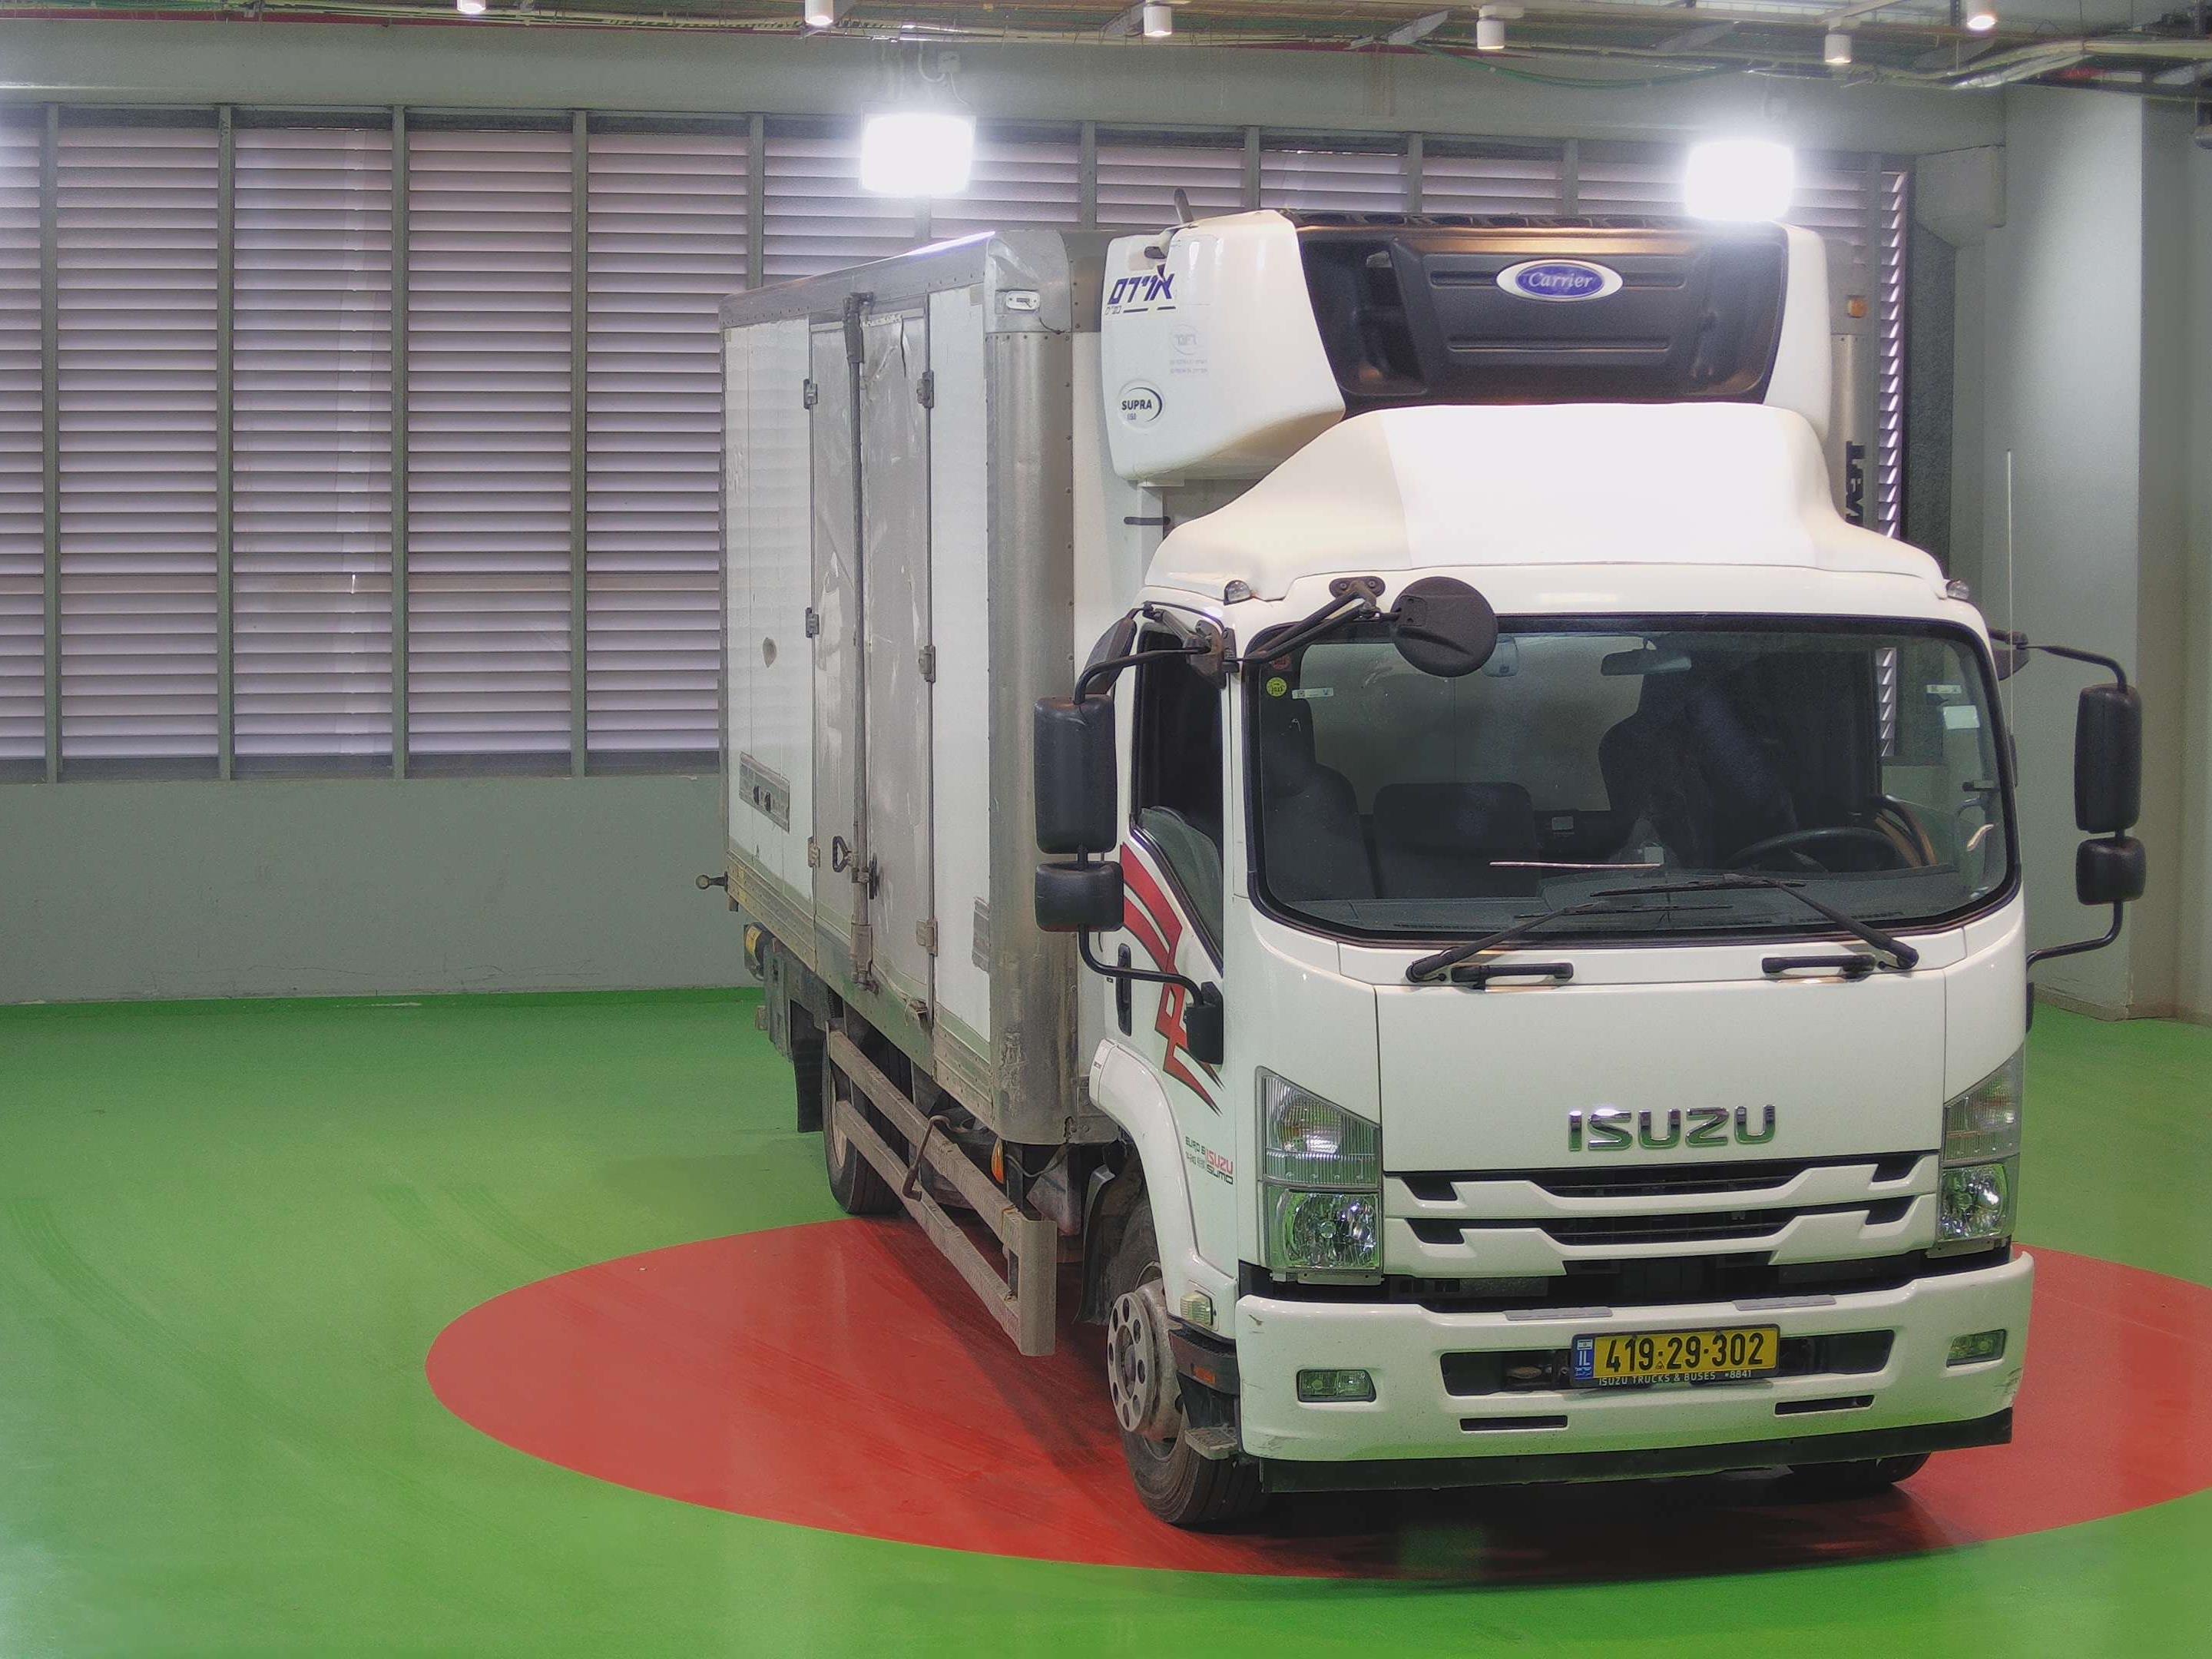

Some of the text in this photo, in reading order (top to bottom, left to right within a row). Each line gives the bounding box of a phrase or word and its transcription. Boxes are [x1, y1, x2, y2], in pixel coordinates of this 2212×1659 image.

[1528, 271, 1593, 288] Carrier
[1121, 399, 1152, 410] SUPRA
[1568, 1104, 1777, 1151] ISUZU
[1206, 1148, 1233, 1175] ISUZU
[1206, 1164, 1233, 1185] SUMO
[1578, 1350, 1591, 1366] IL
[1599, 1377, 1628, 1386] ISUZU
[1632, 1374, 1671, 1384] TRUCKS
[1674, 1373, 1681, 1382] &
[1684, 1371, 1716, 1381] BUSES
